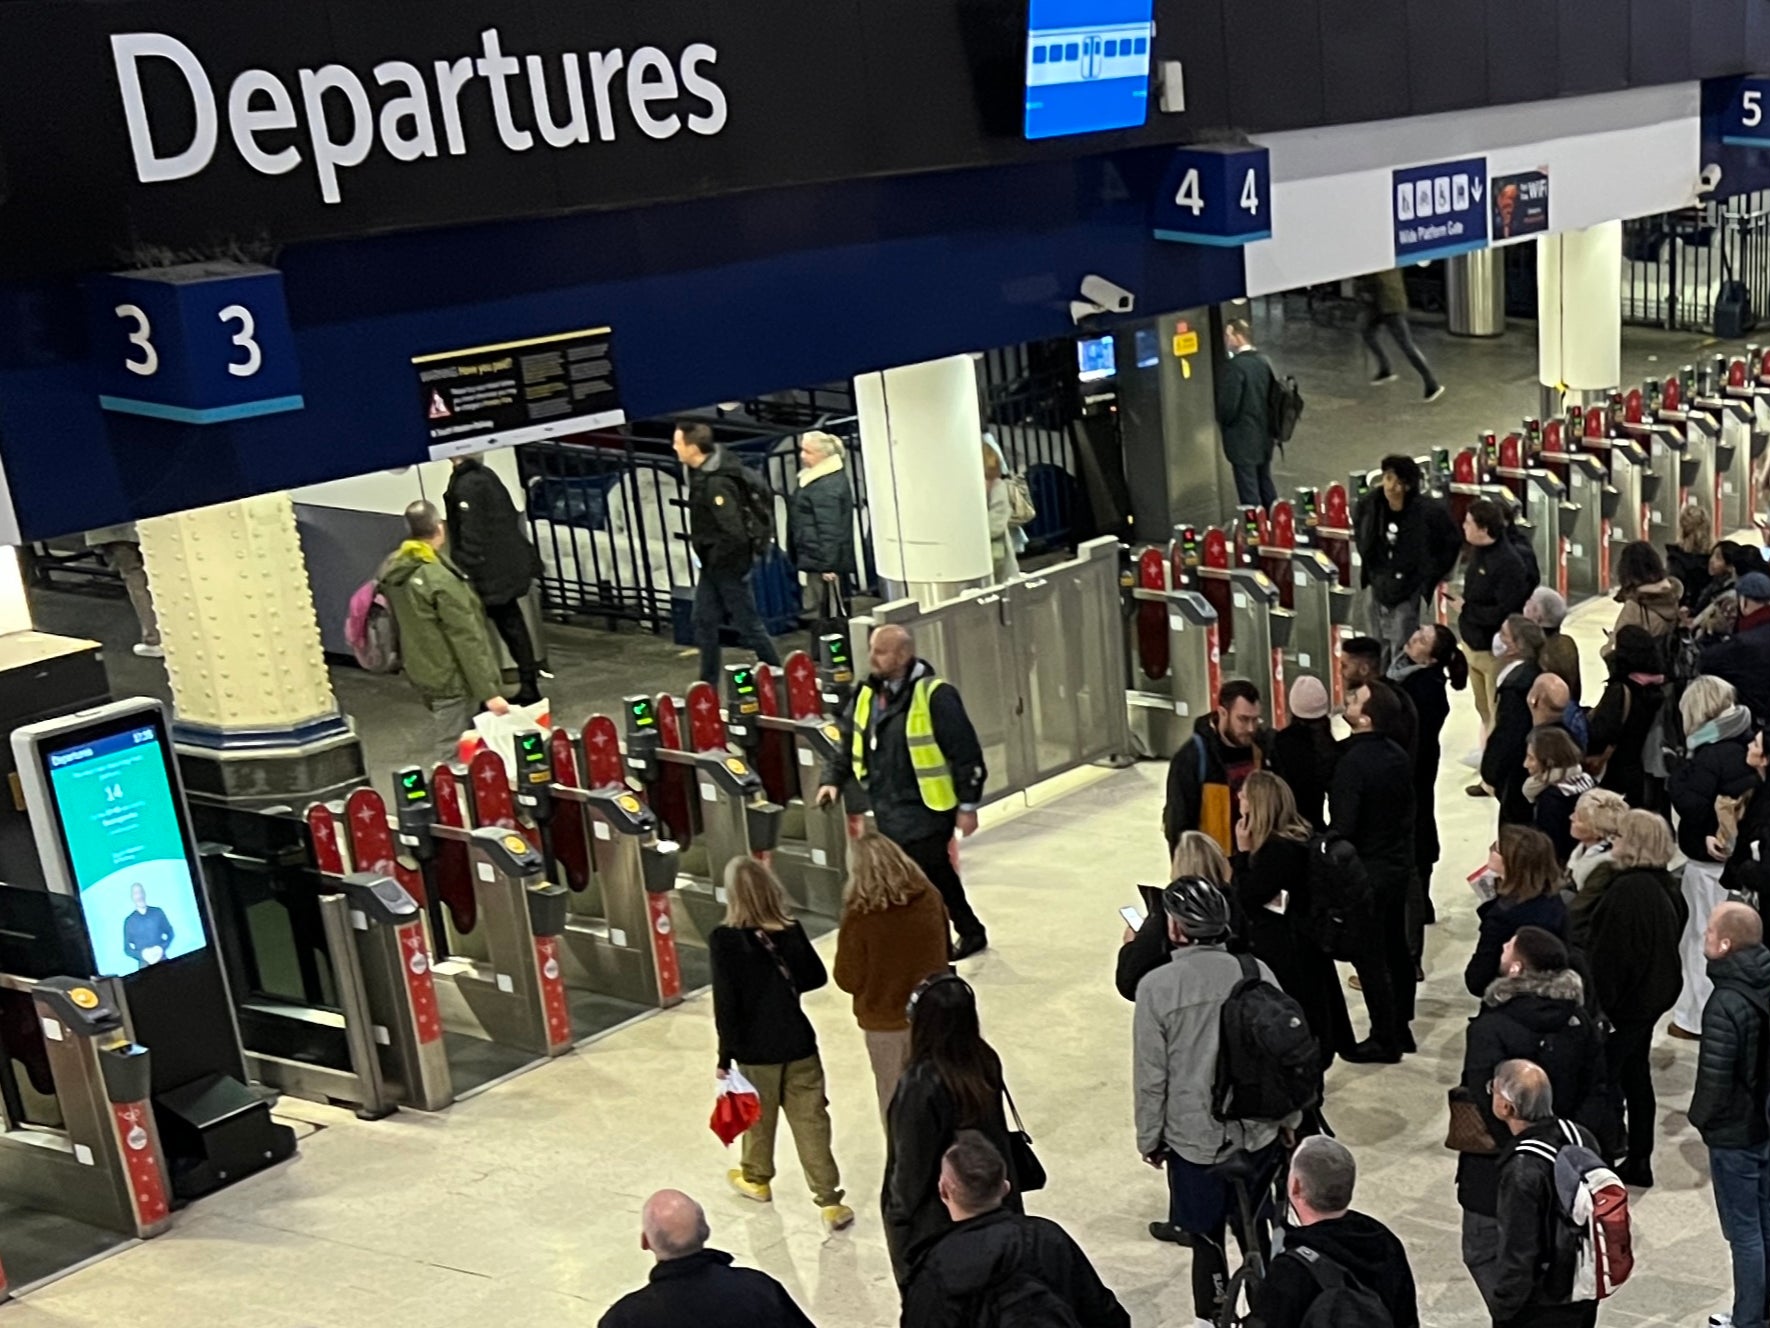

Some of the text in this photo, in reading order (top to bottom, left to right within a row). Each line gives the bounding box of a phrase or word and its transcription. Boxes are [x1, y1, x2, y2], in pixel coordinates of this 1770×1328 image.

[111, 28, 727, 203] Departures
[1742, 91, 1762, 127] 5
[1175, 169, 1204, 215] 4
[1240, 169, 1259, 214] 4
[1418, 223, 1447, 241] Platform
[115, 304, 158, 376] 3
[219, 305, 262, 376] 3
[104, 783, 123, 801] 14
